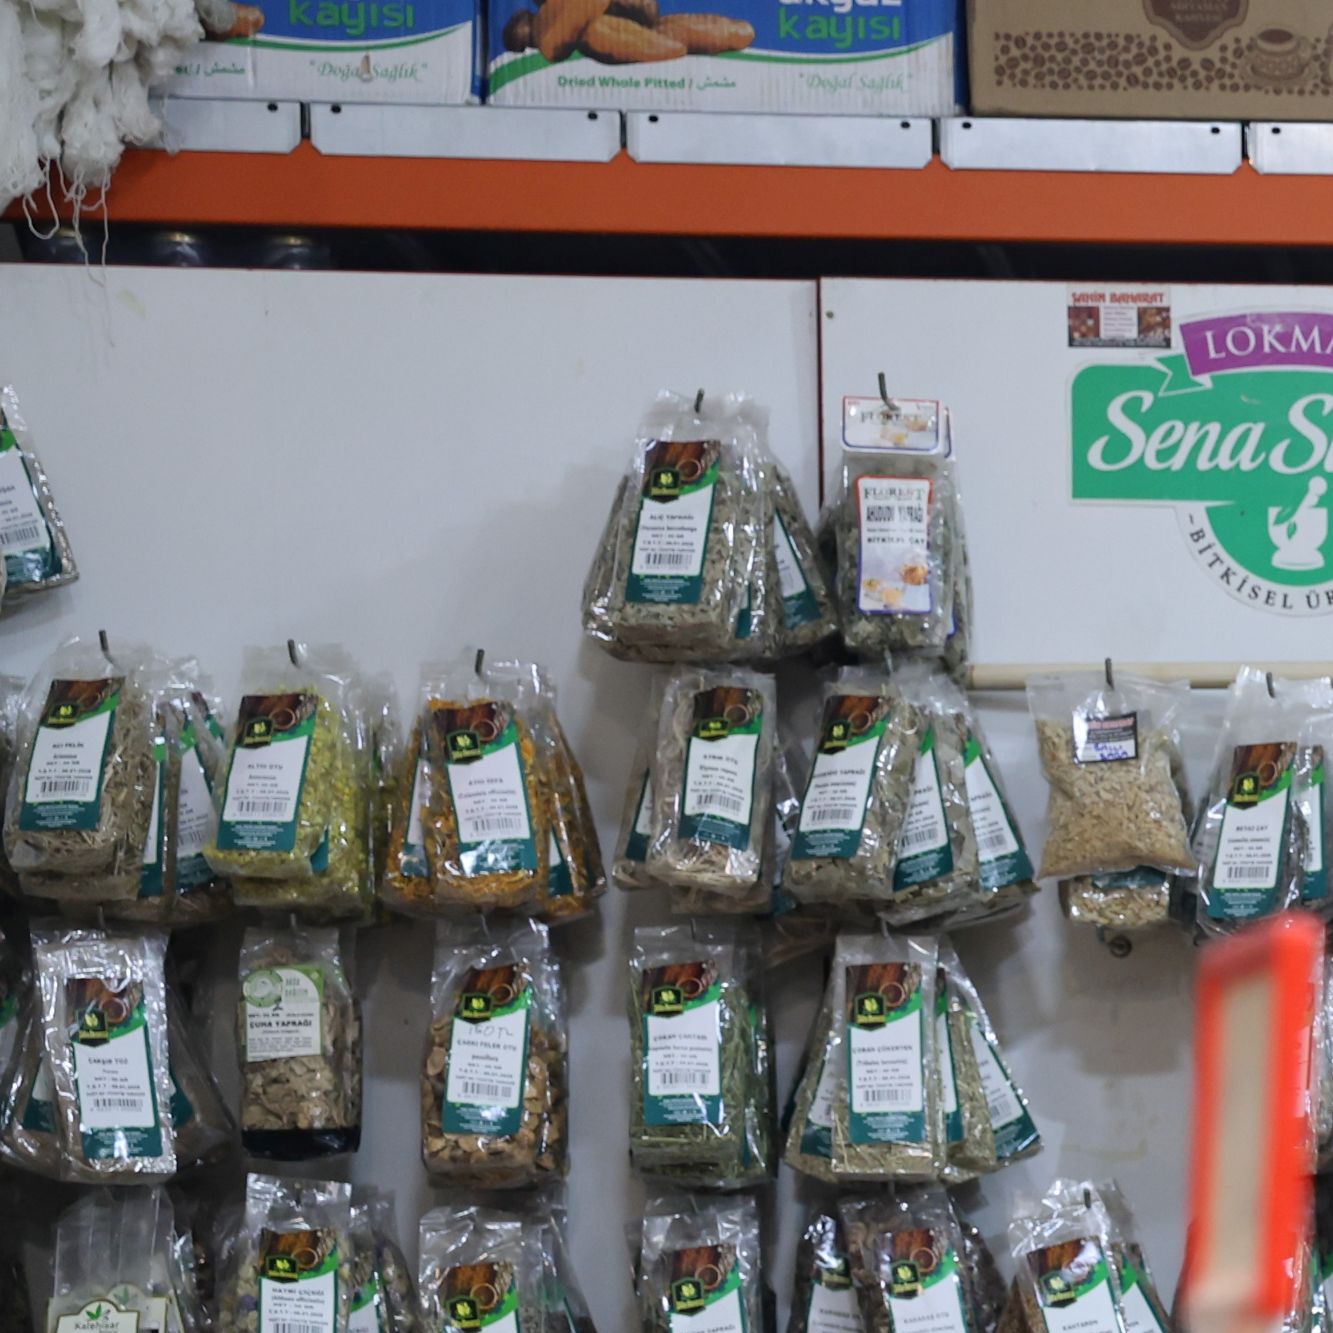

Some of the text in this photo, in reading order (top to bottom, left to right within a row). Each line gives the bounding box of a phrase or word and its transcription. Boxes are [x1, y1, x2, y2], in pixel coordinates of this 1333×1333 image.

[778, 9, 900, 50] kayısı
[557, 75, 596, 88] Dried
[599, 75, 641, 89] Whole
[643, 76, 686, 90] Pitted
[1086, 389, 1266, 472] Sena
[277, 1020, 312, 1029] YAPRAĞI
